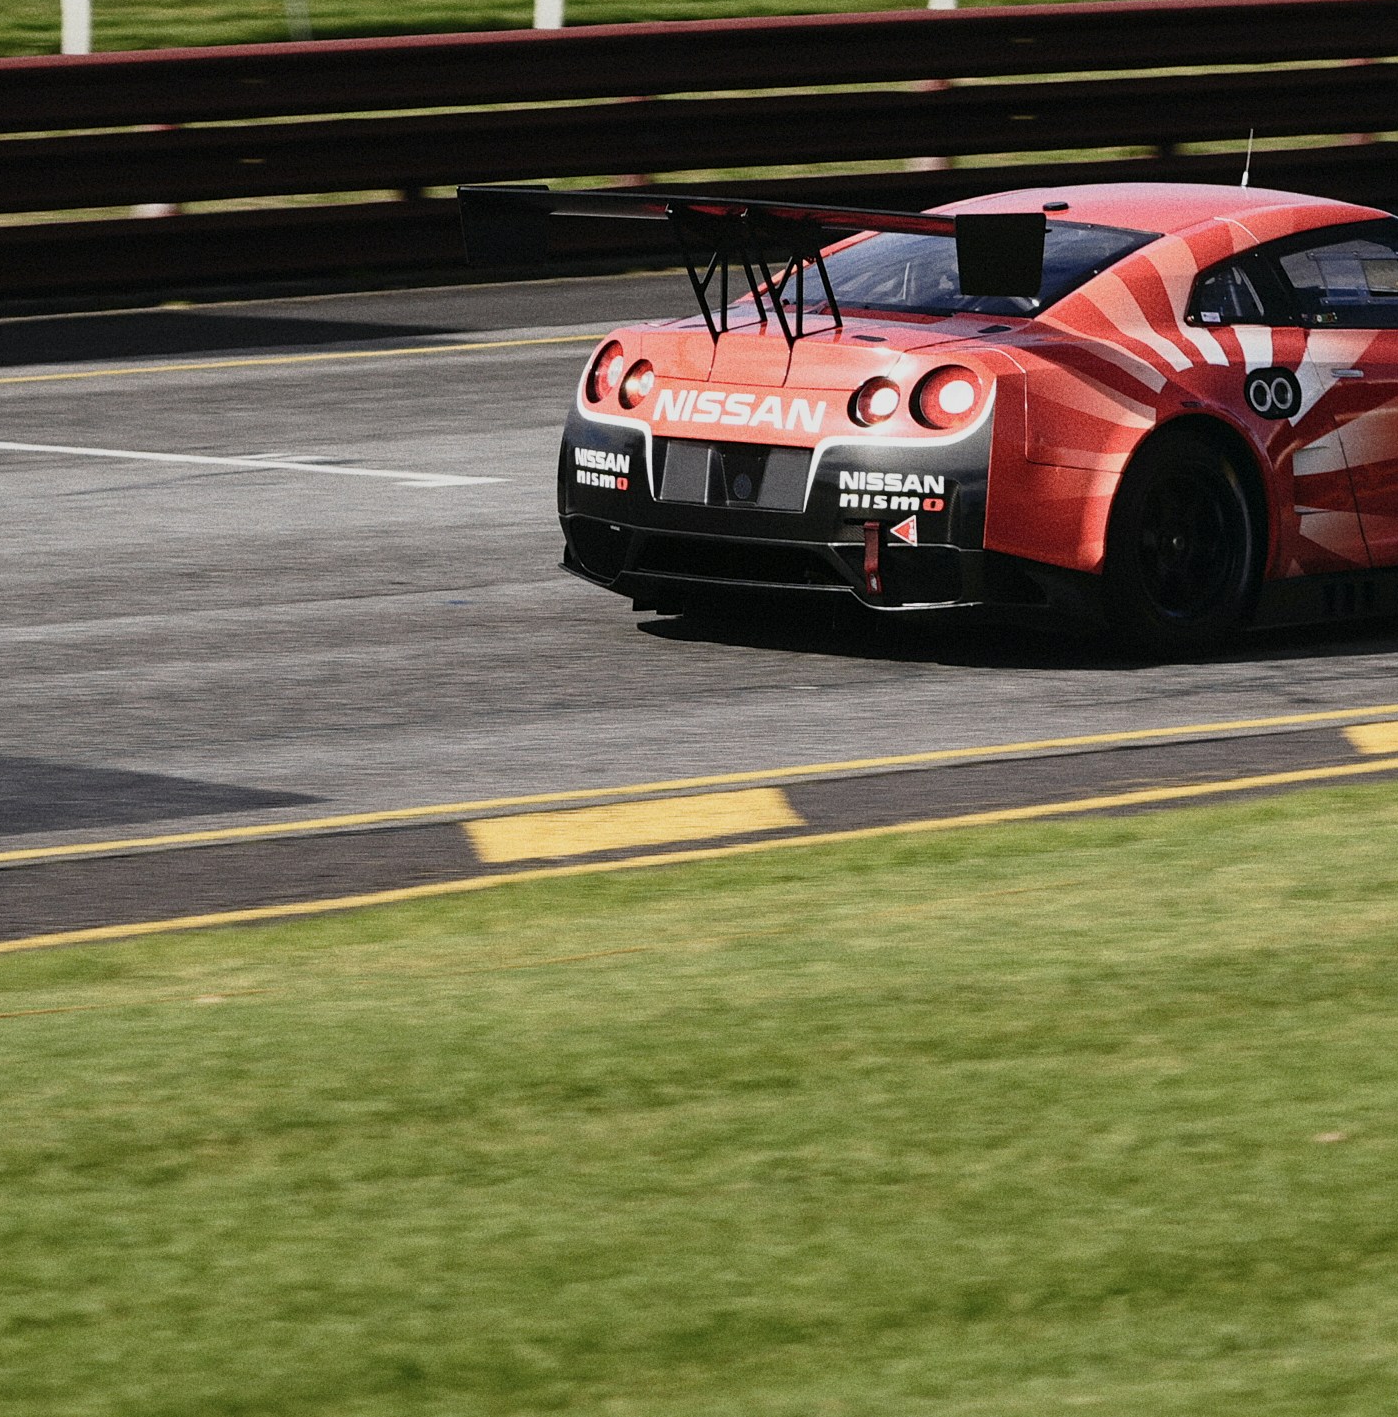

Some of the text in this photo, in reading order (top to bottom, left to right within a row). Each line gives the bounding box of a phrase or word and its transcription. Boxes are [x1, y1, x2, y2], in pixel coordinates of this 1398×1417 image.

[653, 389, 826, 433] NISSAN
[575, 447, 630, 474] NISSAN
[839, 470, 945, 494] NISSAN
